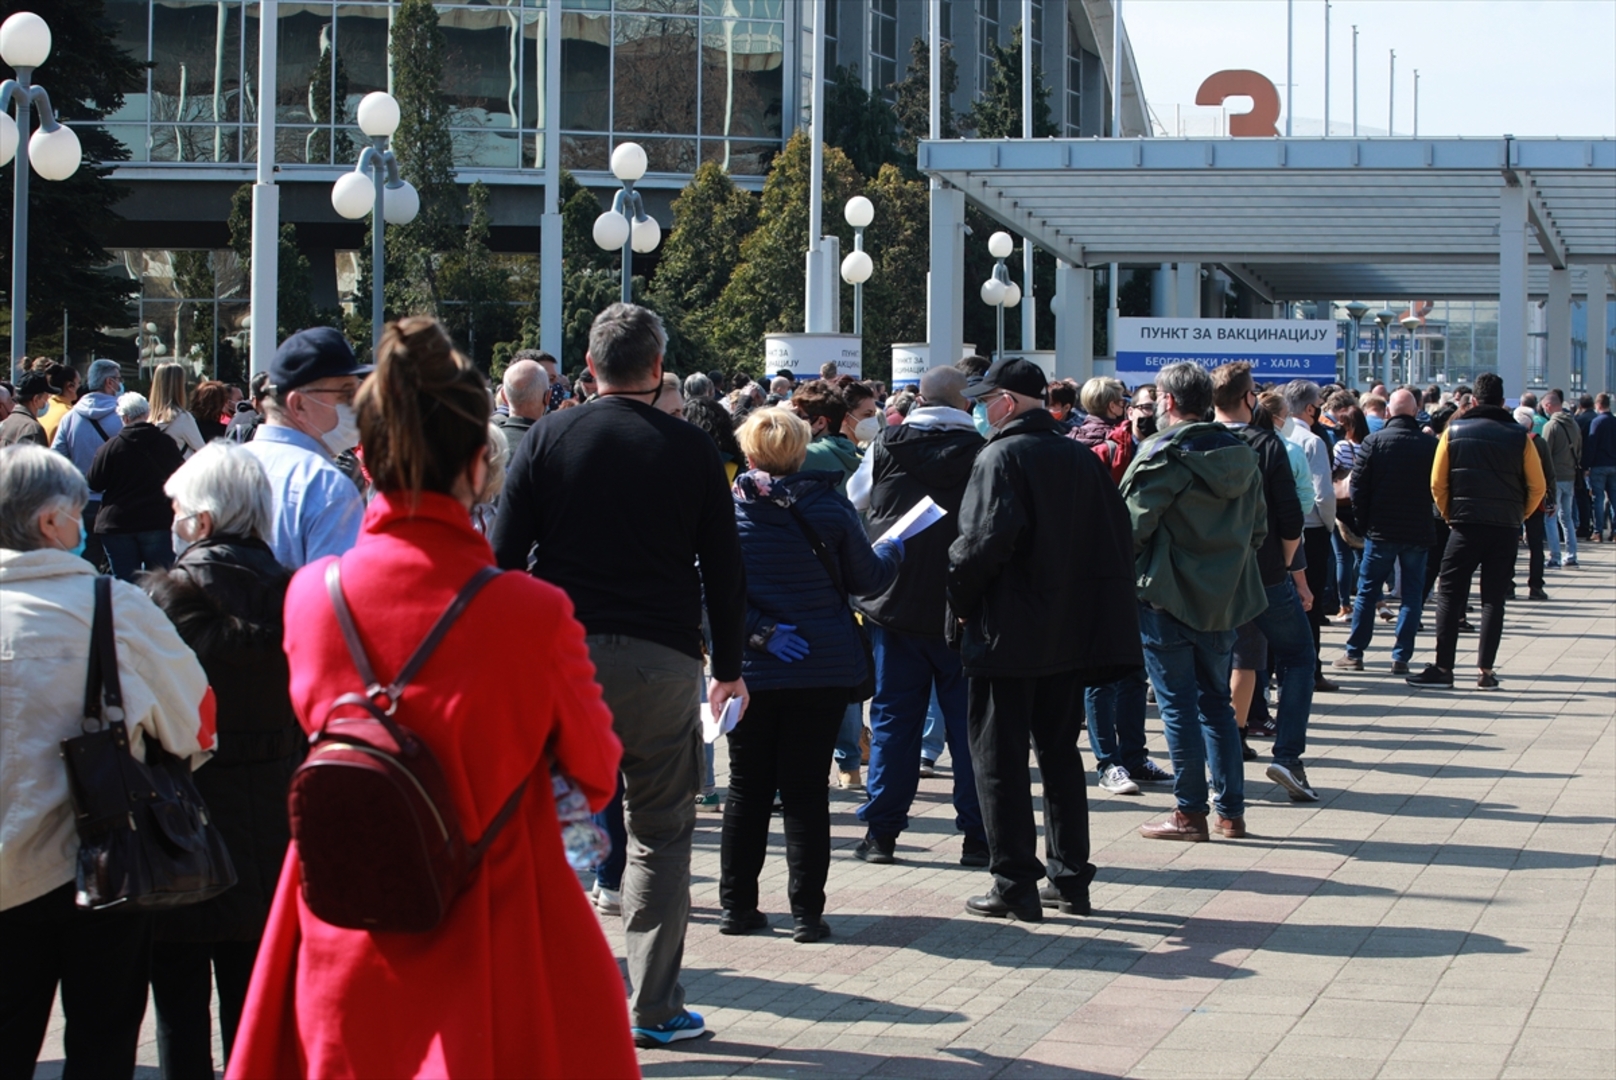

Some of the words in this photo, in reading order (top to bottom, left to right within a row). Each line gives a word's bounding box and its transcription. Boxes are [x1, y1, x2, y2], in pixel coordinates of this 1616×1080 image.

[1140, 326, 1189, 340] ПУНКТ
[1192, 327, 1212, 340] ЗА
[1217, 327, 1328, 343] ВАКЦИНАЦИЈУ
[914, 356, 924, 364] ЗА
[1270, 359, 1300, 368] ХАЛА
